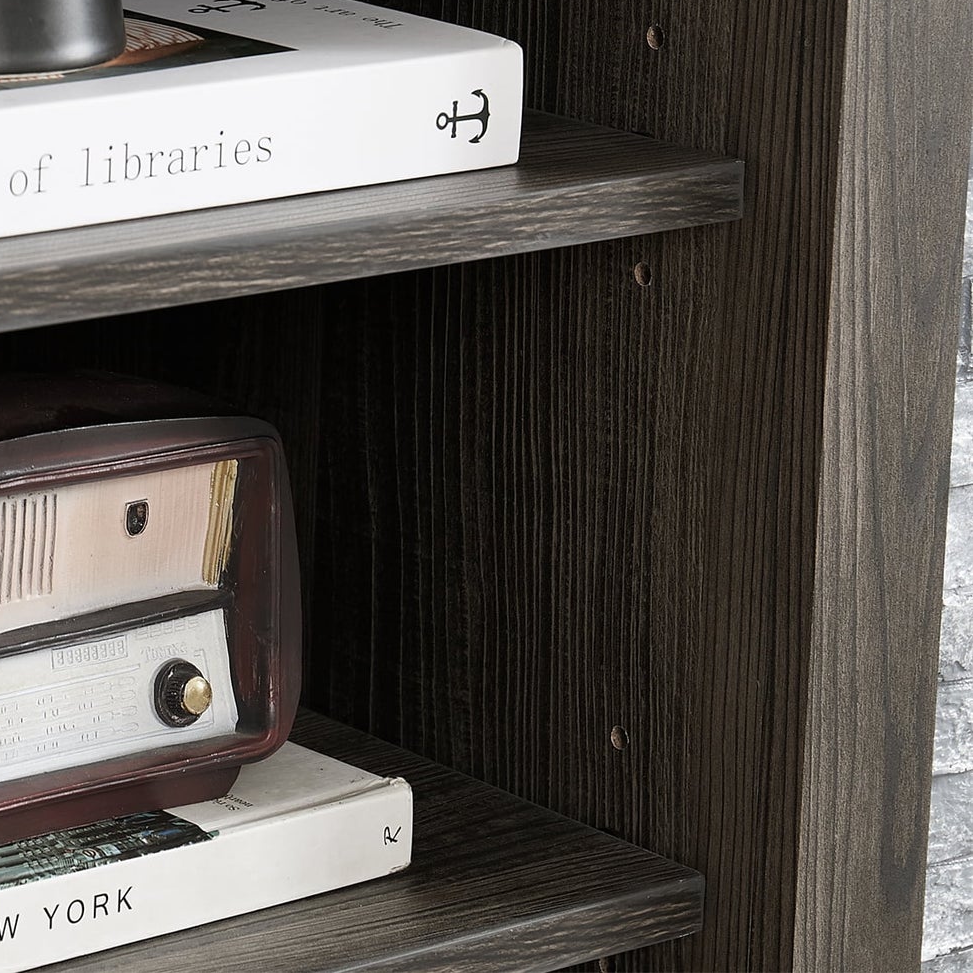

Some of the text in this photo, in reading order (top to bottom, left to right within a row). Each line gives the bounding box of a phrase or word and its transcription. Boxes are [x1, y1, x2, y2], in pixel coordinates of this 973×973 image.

[8, 152, 54, 196] of
[79, 129, 274, 188] libraries
[42, 885, 135, 931] YORK
